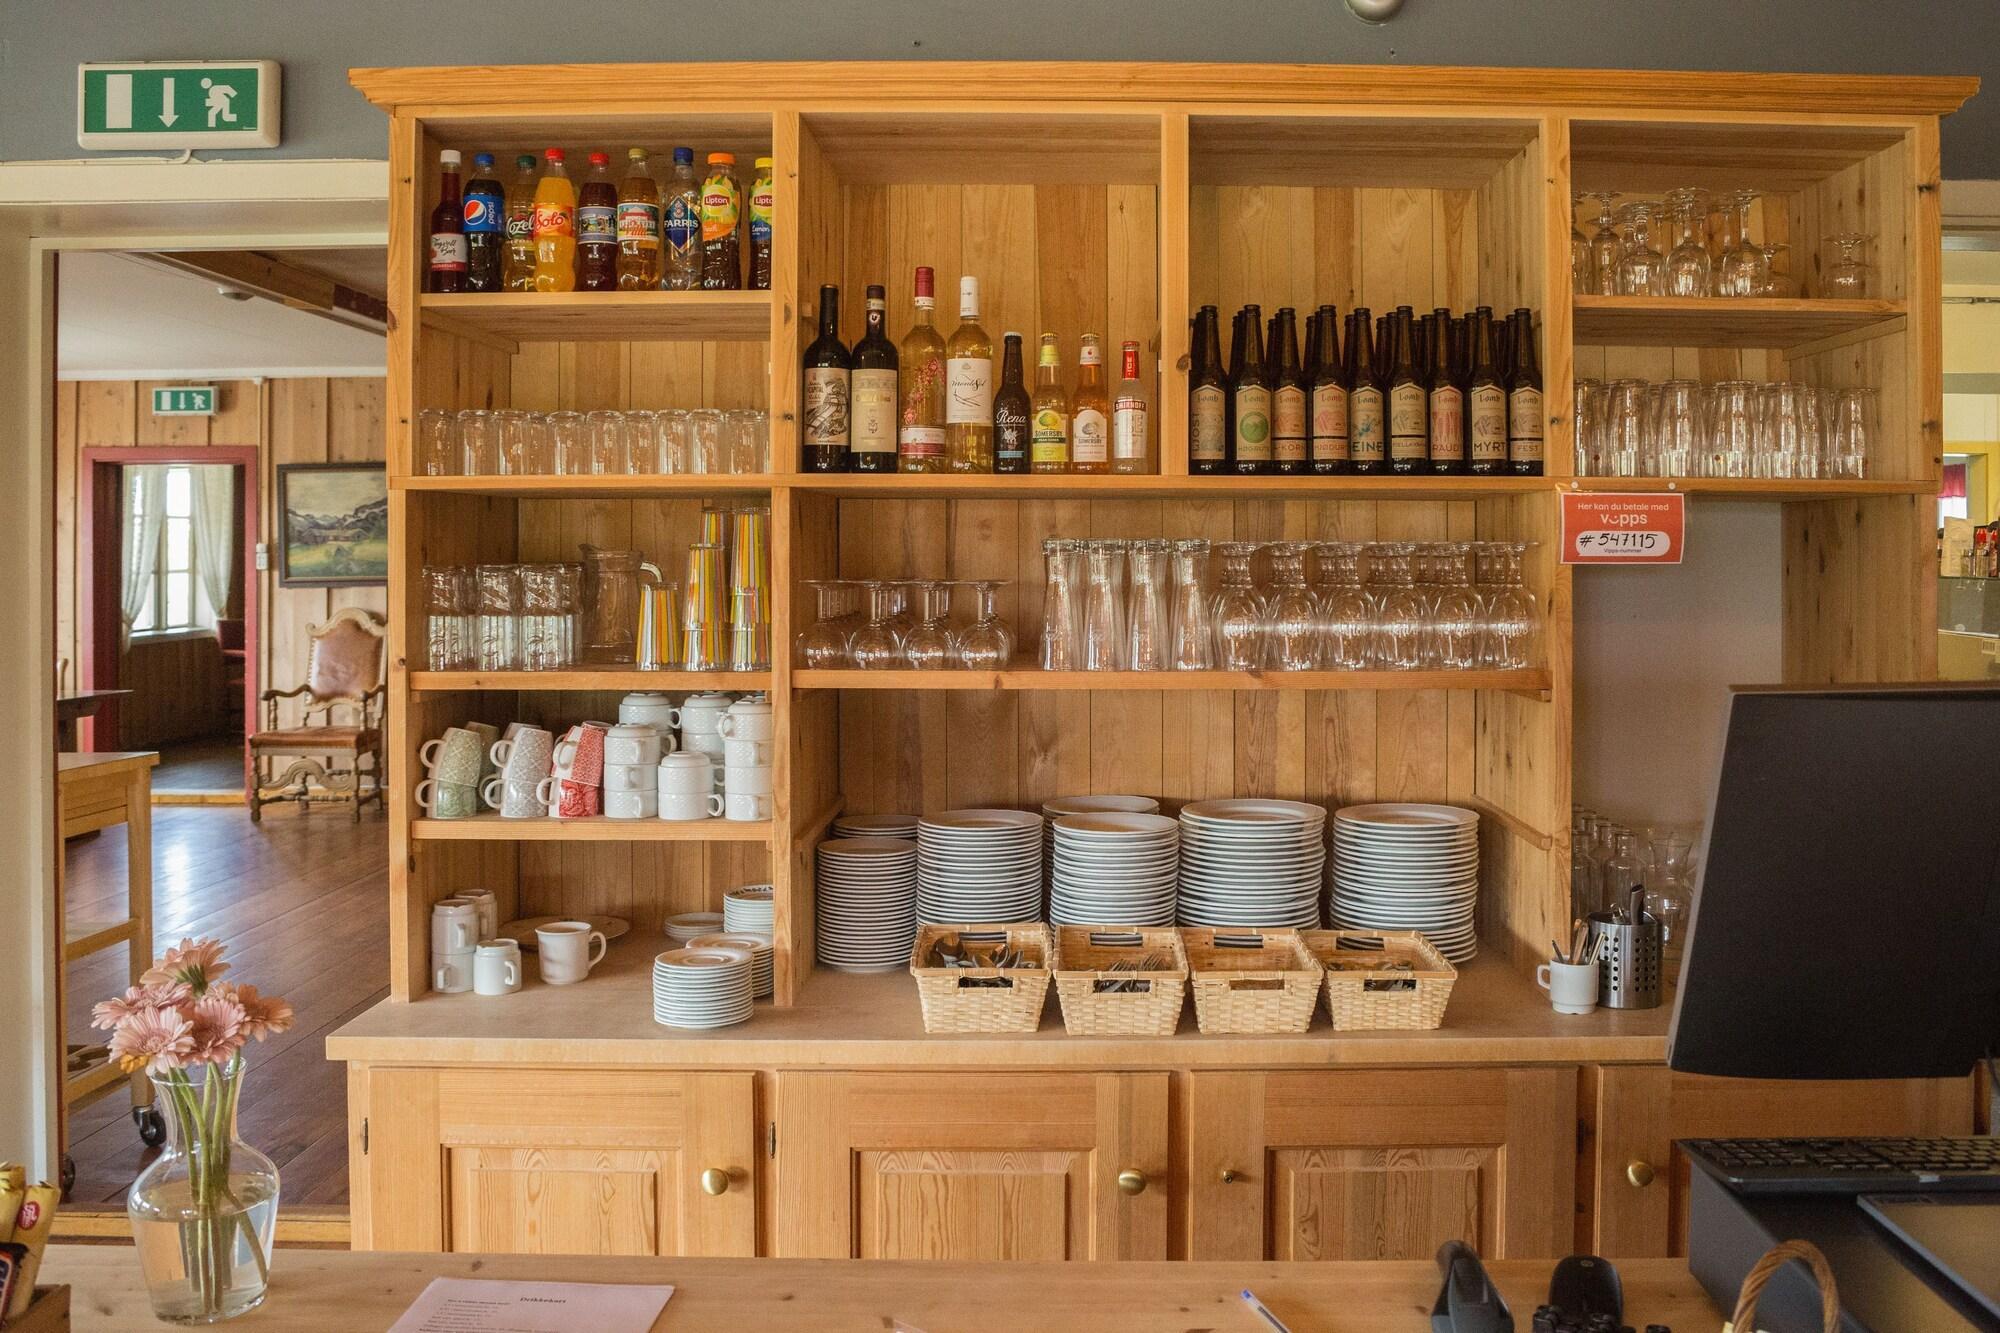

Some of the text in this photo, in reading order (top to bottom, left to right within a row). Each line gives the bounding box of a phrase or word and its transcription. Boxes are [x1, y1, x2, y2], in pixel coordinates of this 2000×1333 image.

[705, 197, 728, 205] Lipton
[755, 197, 773, 205] Lipto
[487, 201, 496, 225] pepsi
[536, 208, 565, 231] Solo
[506, 215, 535, 239] Cozel
[664, 219, 699, 228] FARRIS
[1115, 400, 1145, 410] SMIRNOFF
[996, 408, 1026, 424] Rena
[1623, 503, 1649, 511] betale
[1651, 503, 1669, 511] med
[1598, 533, 1658, 549] 547115
